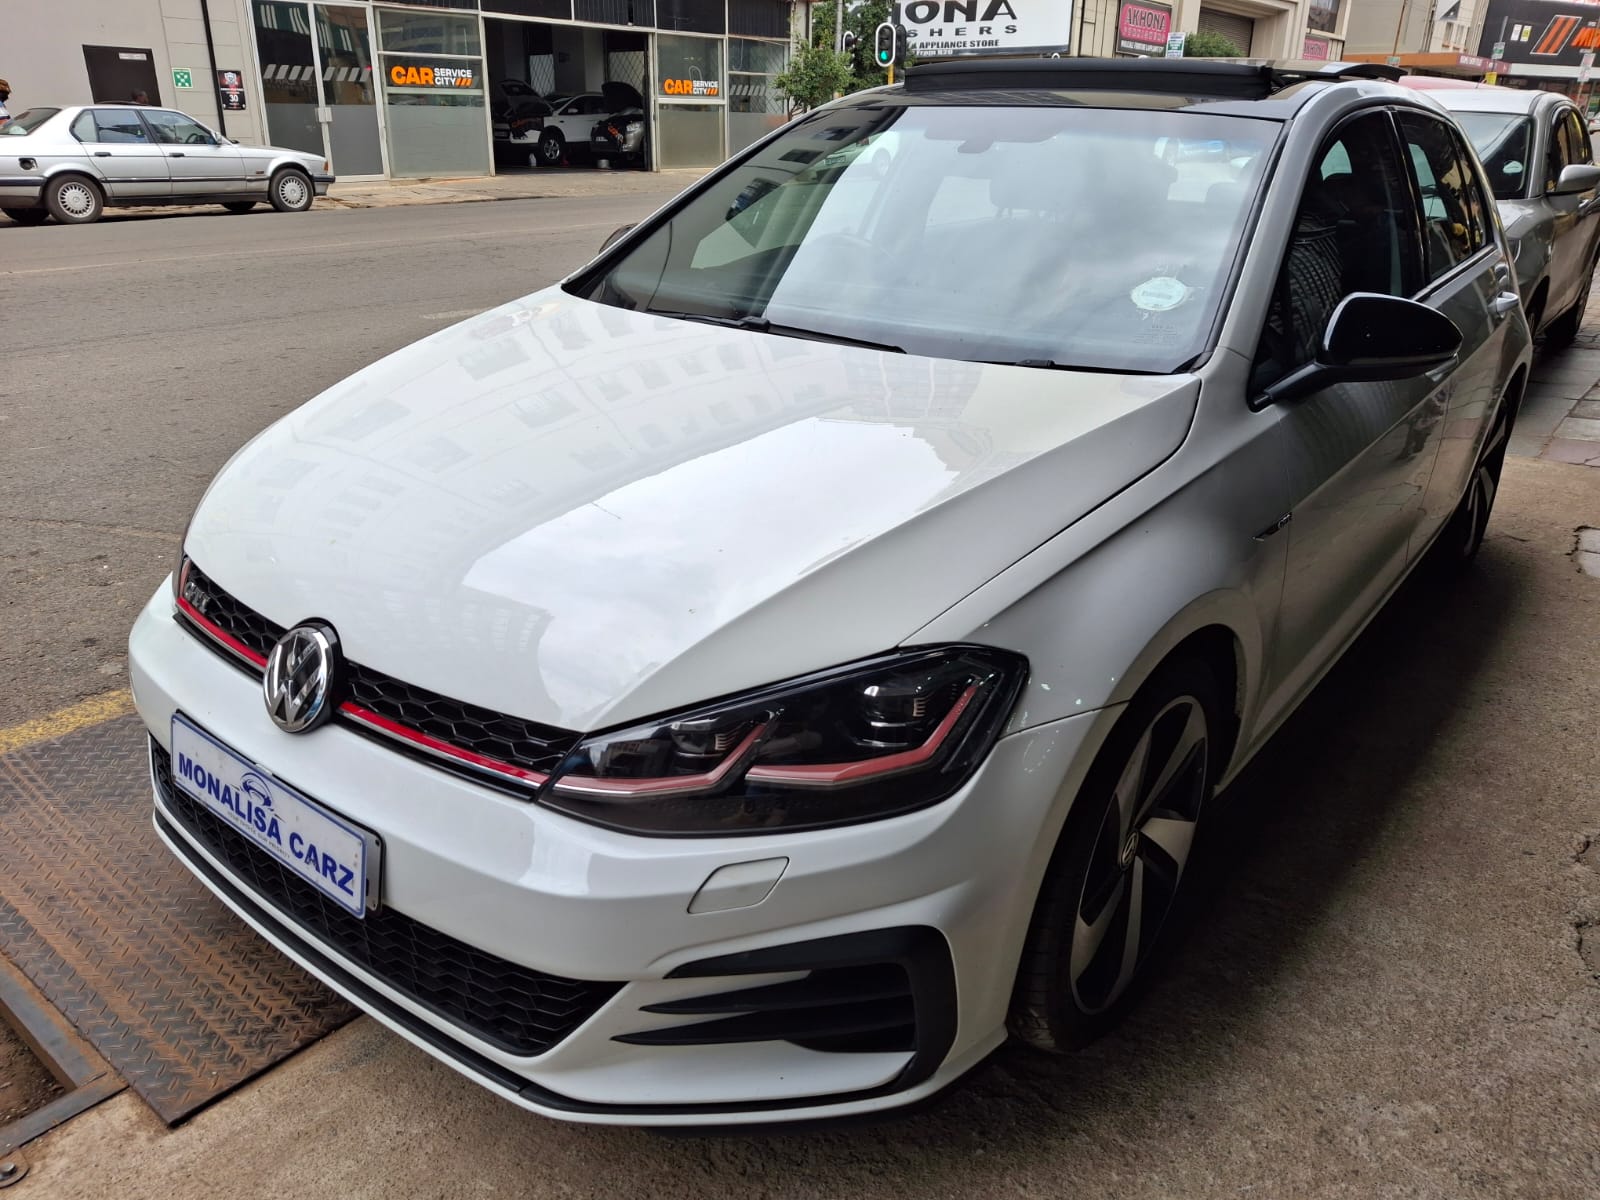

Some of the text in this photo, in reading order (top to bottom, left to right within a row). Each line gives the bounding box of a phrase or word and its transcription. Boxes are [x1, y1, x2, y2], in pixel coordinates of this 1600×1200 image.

[1126, 7, 1166, 31] AKHONA
[919, 40, 967, 49] APPLIANCE
[969, 39, 1000, 47] STORE
[391, 66, 472, 85] CAR SERVICE
[434, 77, 457, 86] CITY
[664, 78, 719, 95] CAR SERVICE
[693, 87, 708, 95] CITY
[229, 94, 239, 102] 30
[178, 752, 354, 897] MONALISA CARZ
